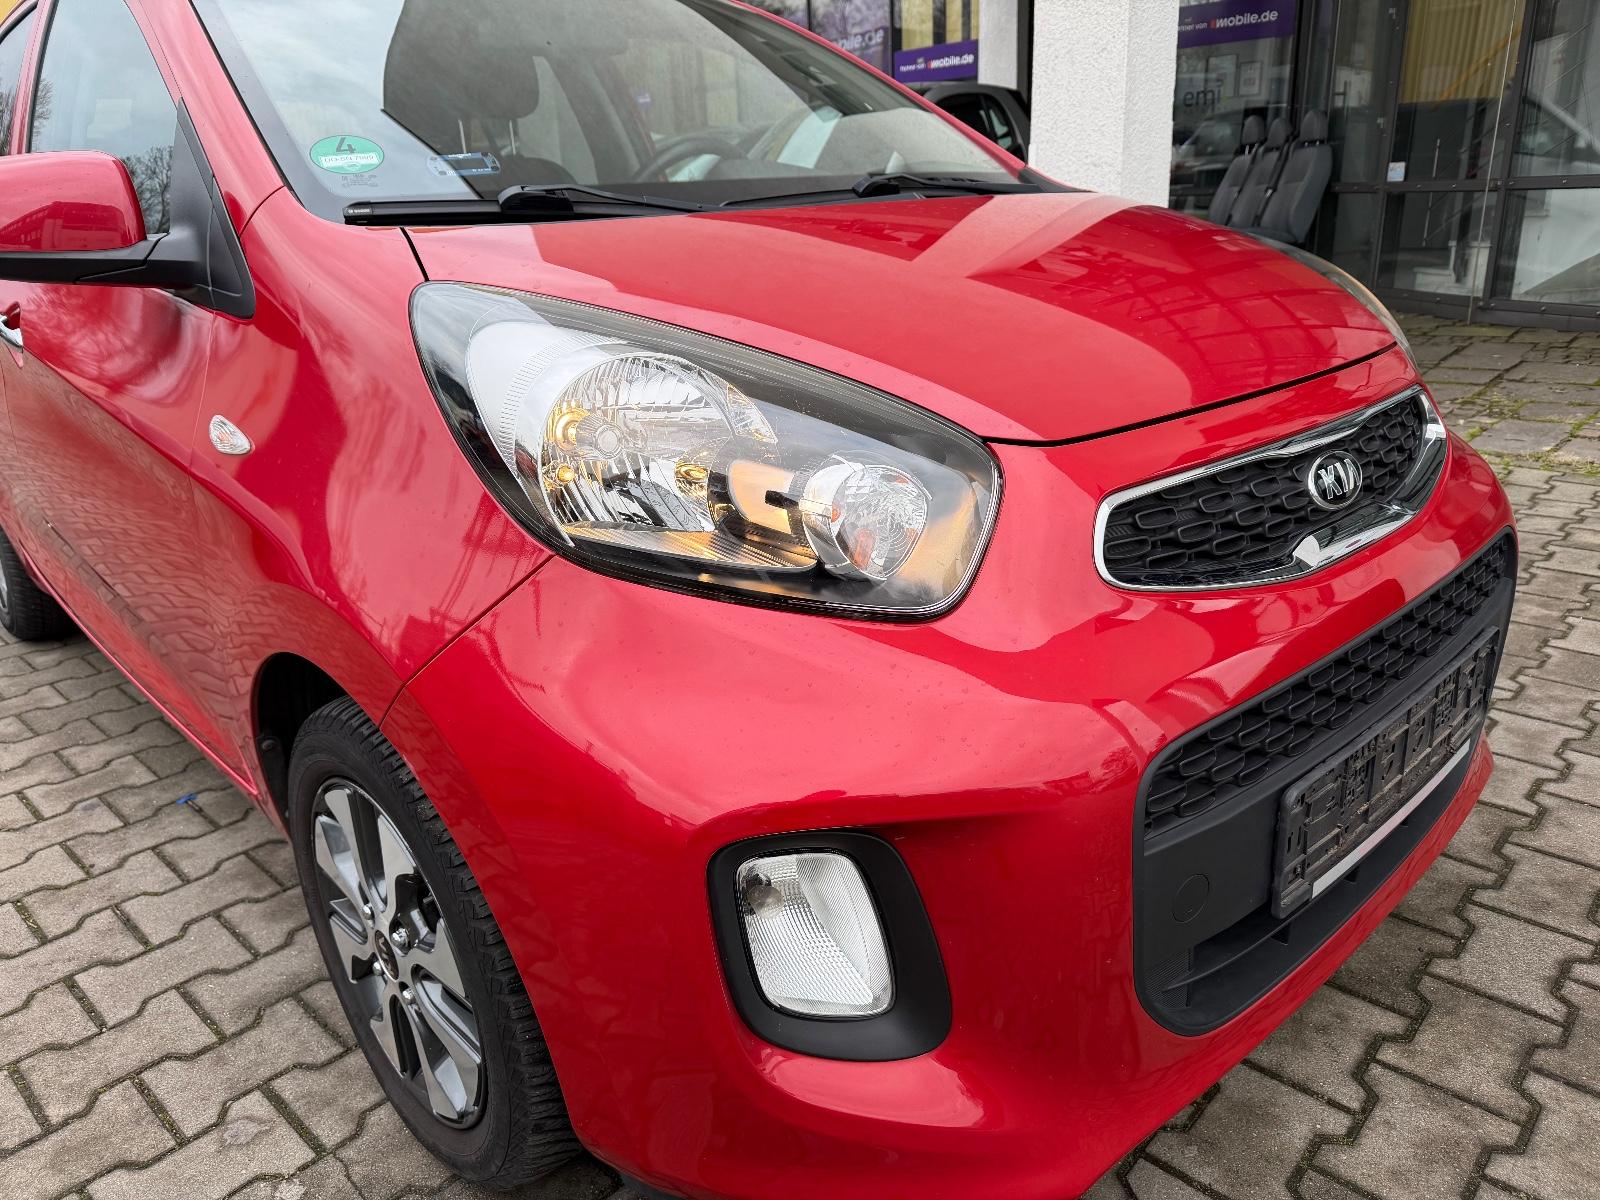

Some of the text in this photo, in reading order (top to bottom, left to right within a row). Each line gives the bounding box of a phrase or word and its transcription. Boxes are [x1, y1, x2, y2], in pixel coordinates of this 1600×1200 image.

[1213, 10, 1279, 29] mobile.de
[336, 137, 356, 153] 4
[1318, 459, 1360, 499] KIA
